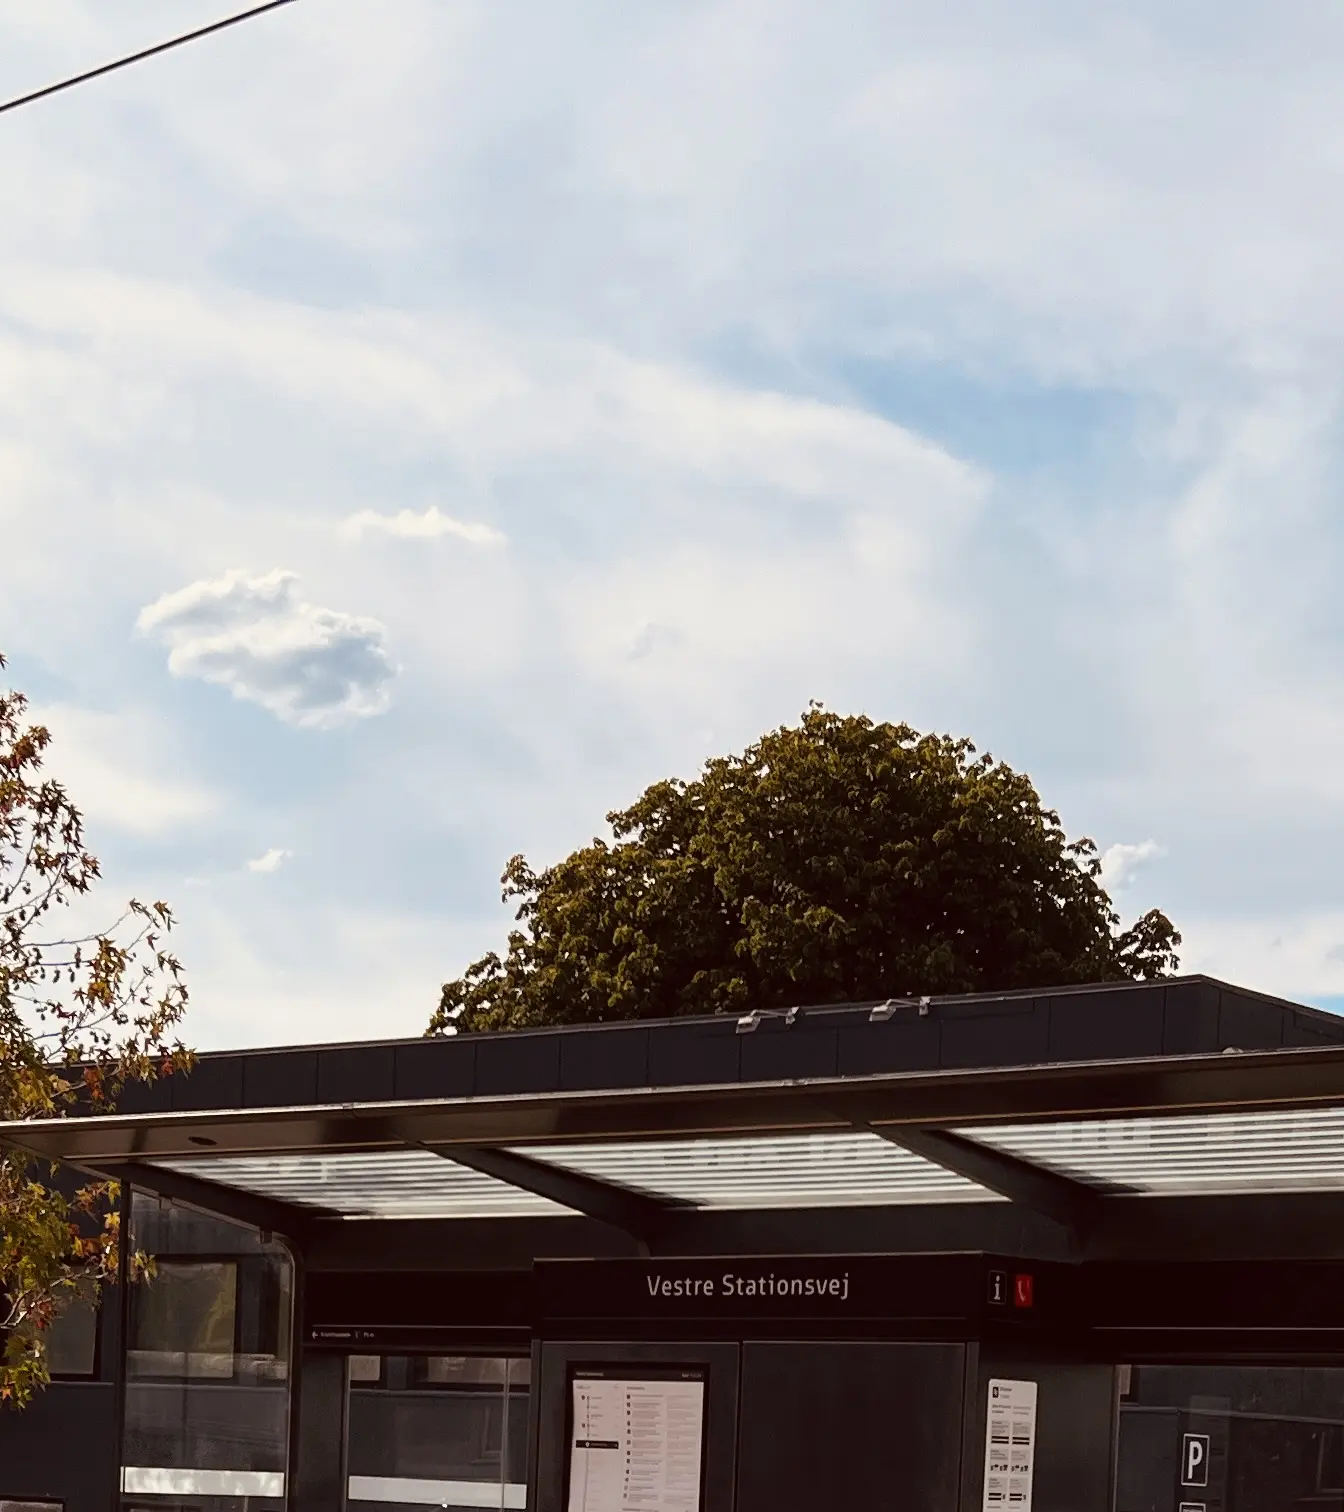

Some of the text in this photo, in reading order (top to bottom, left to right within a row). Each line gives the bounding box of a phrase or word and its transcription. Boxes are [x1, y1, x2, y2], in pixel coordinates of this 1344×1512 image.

[646, 1272, 849, 1300] Vestre Stationsvej
[1187, 1440, 1204, 1480] P
